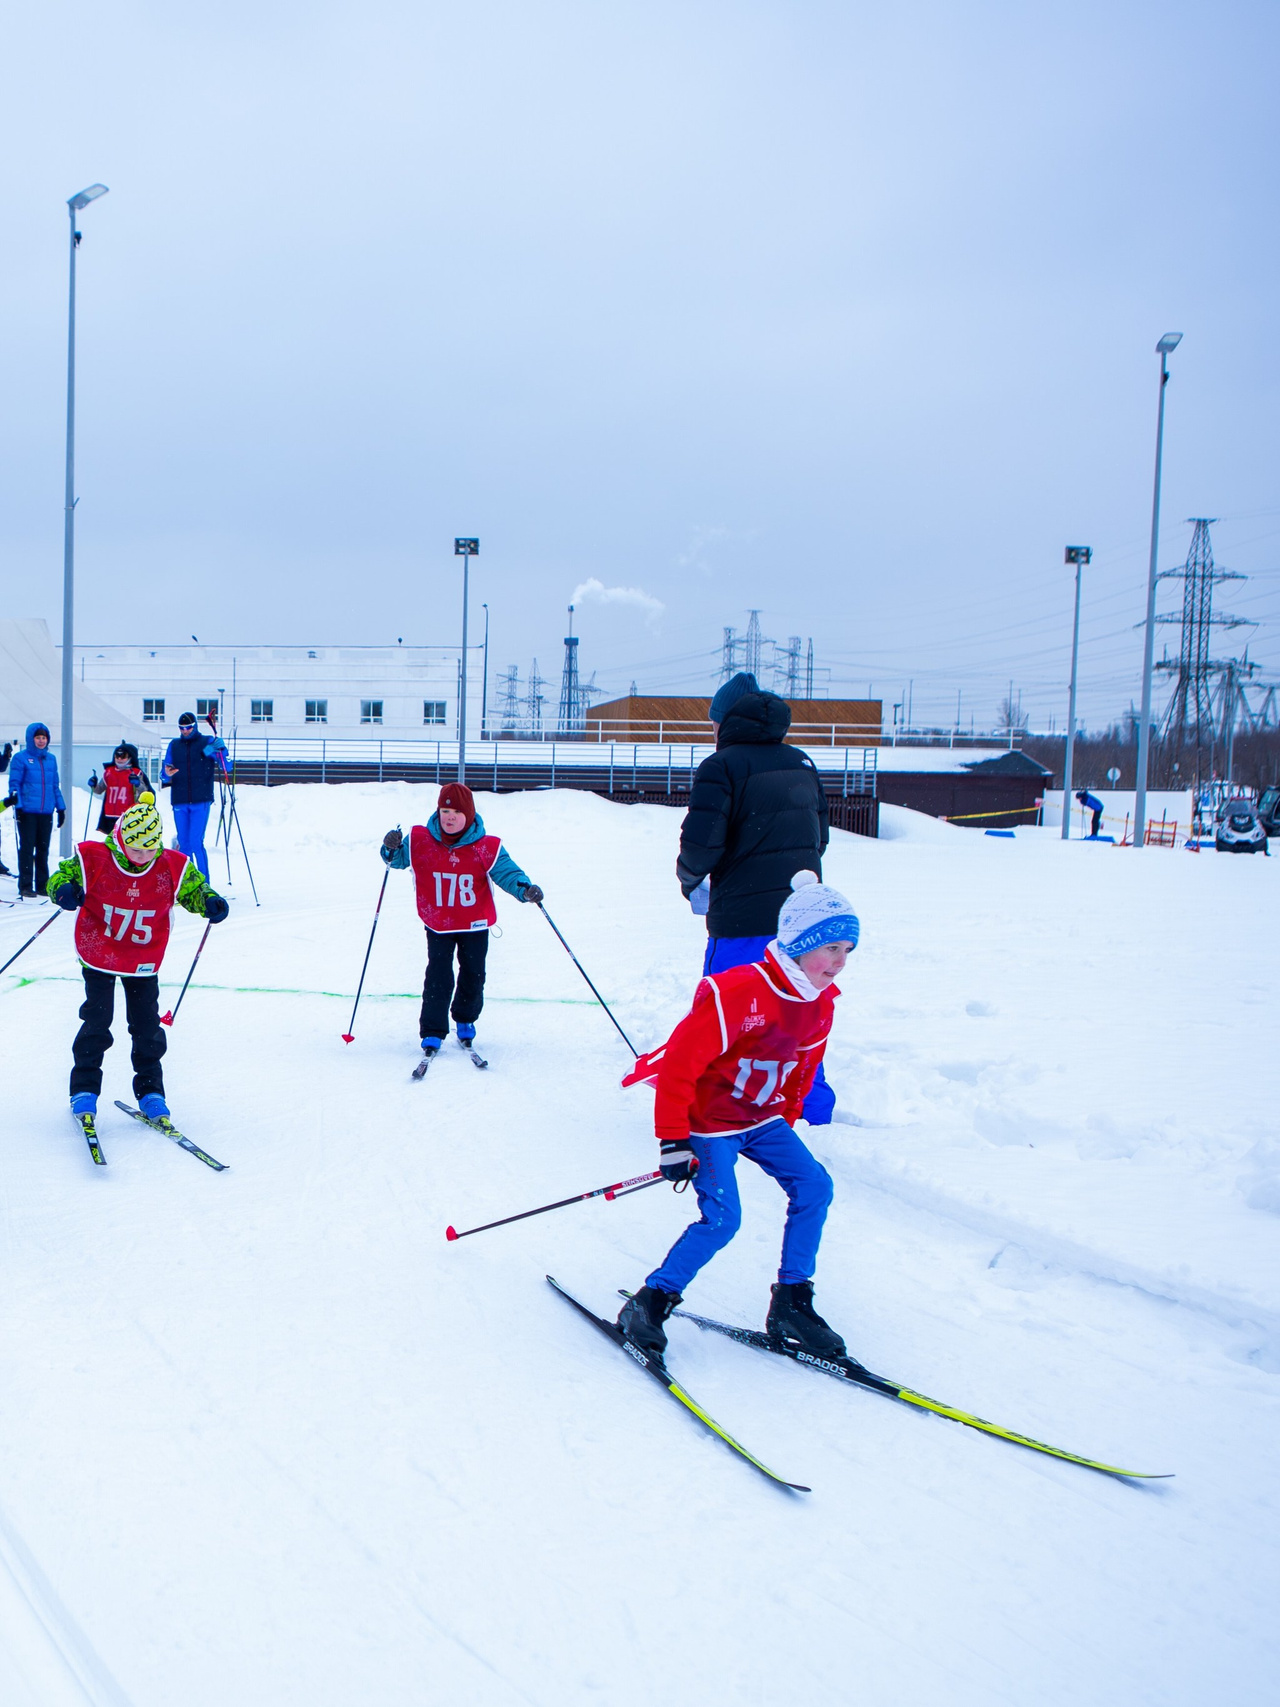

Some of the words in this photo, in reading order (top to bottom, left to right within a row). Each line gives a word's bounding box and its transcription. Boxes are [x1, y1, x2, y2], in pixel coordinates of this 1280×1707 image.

[108, 786, 127, 804] 174
[432, 871, 477, 908] 178
[102, 903, 157, 946] 175
[622, 1340, 651, 1368] BRADOS
[796, 1351, 849, 1378] BRADOS
